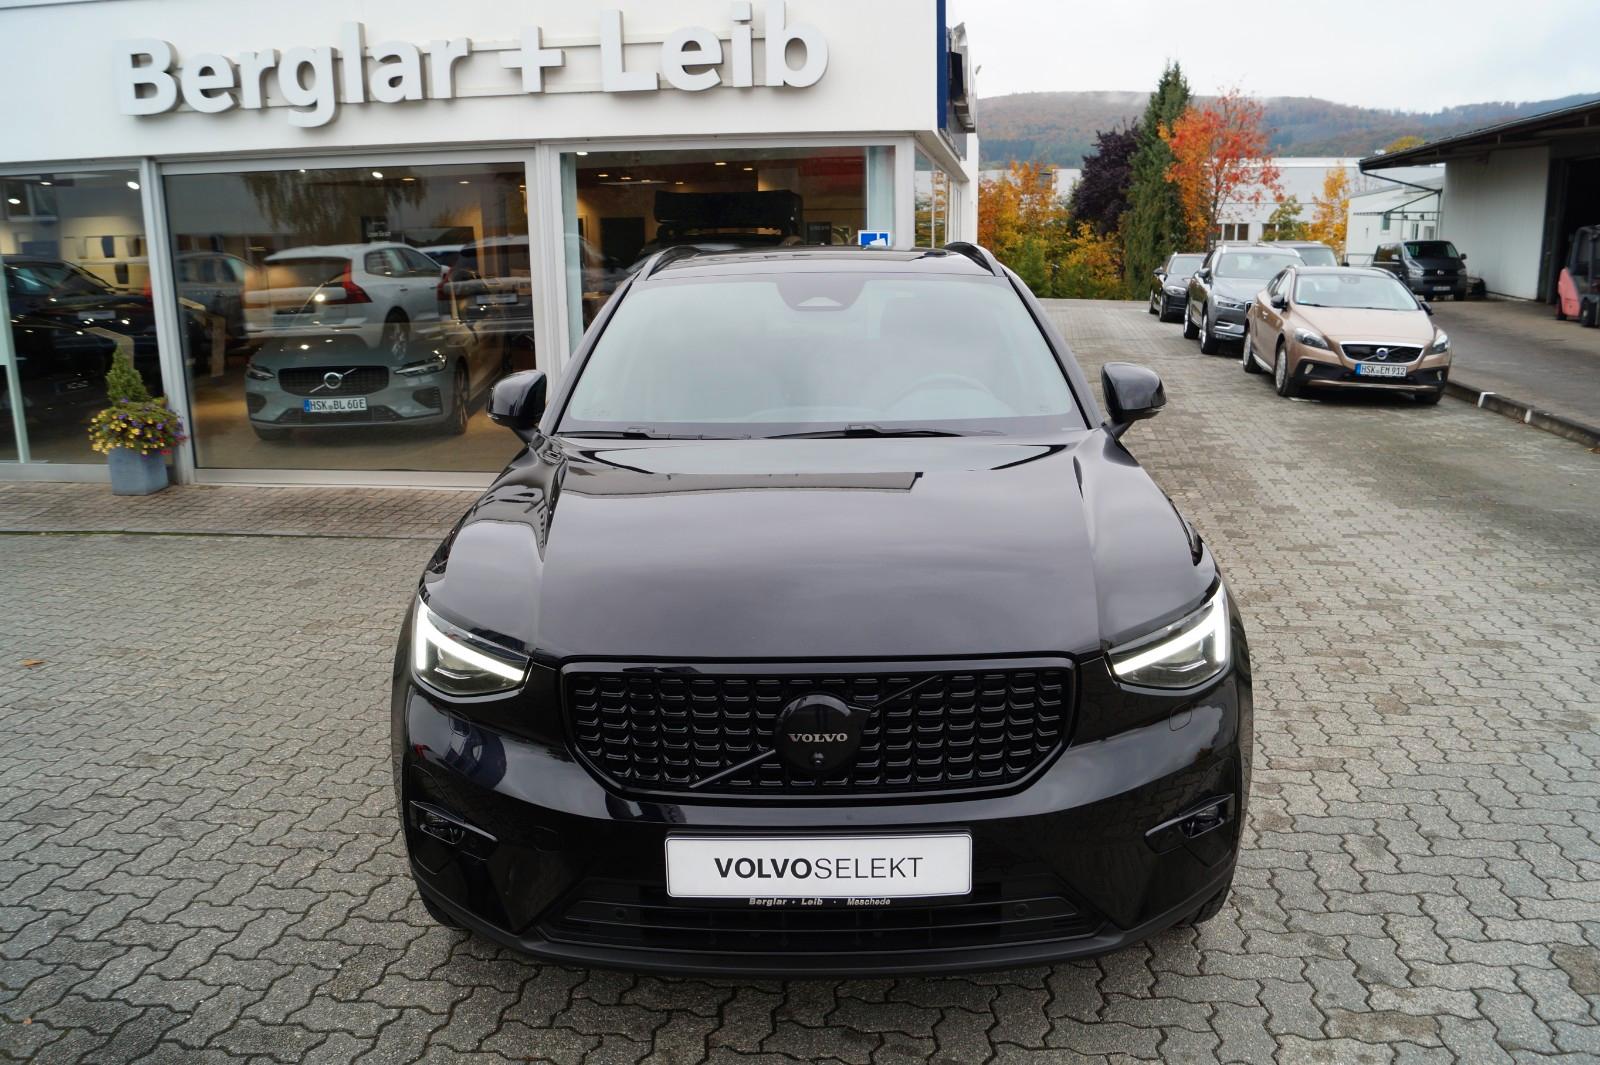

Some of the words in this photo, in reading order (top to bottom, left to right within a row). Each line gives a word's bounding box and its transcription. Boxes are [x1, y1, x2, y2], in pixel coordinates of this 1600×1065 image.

[113, 22, 473, 128] Berglar
[499, 25, 566, 93] +
[599, 0, 829, 92] Leib
[1361, 365, 1375, 374] HSK
[1380, 366, 1390, 375] EM
[1391, 366, 1406, 376] 912
[310, 400, 327, 411] HSK
[333, 400, 345, 410] BL
[347, 399, 365, 409] 60E
[788, 732, 848, 743] VOLVO
[749, 898, 787, 907] Berglar
[801, 898, 823, 906] Leib
[847, 898, 891, 906] Meschede
